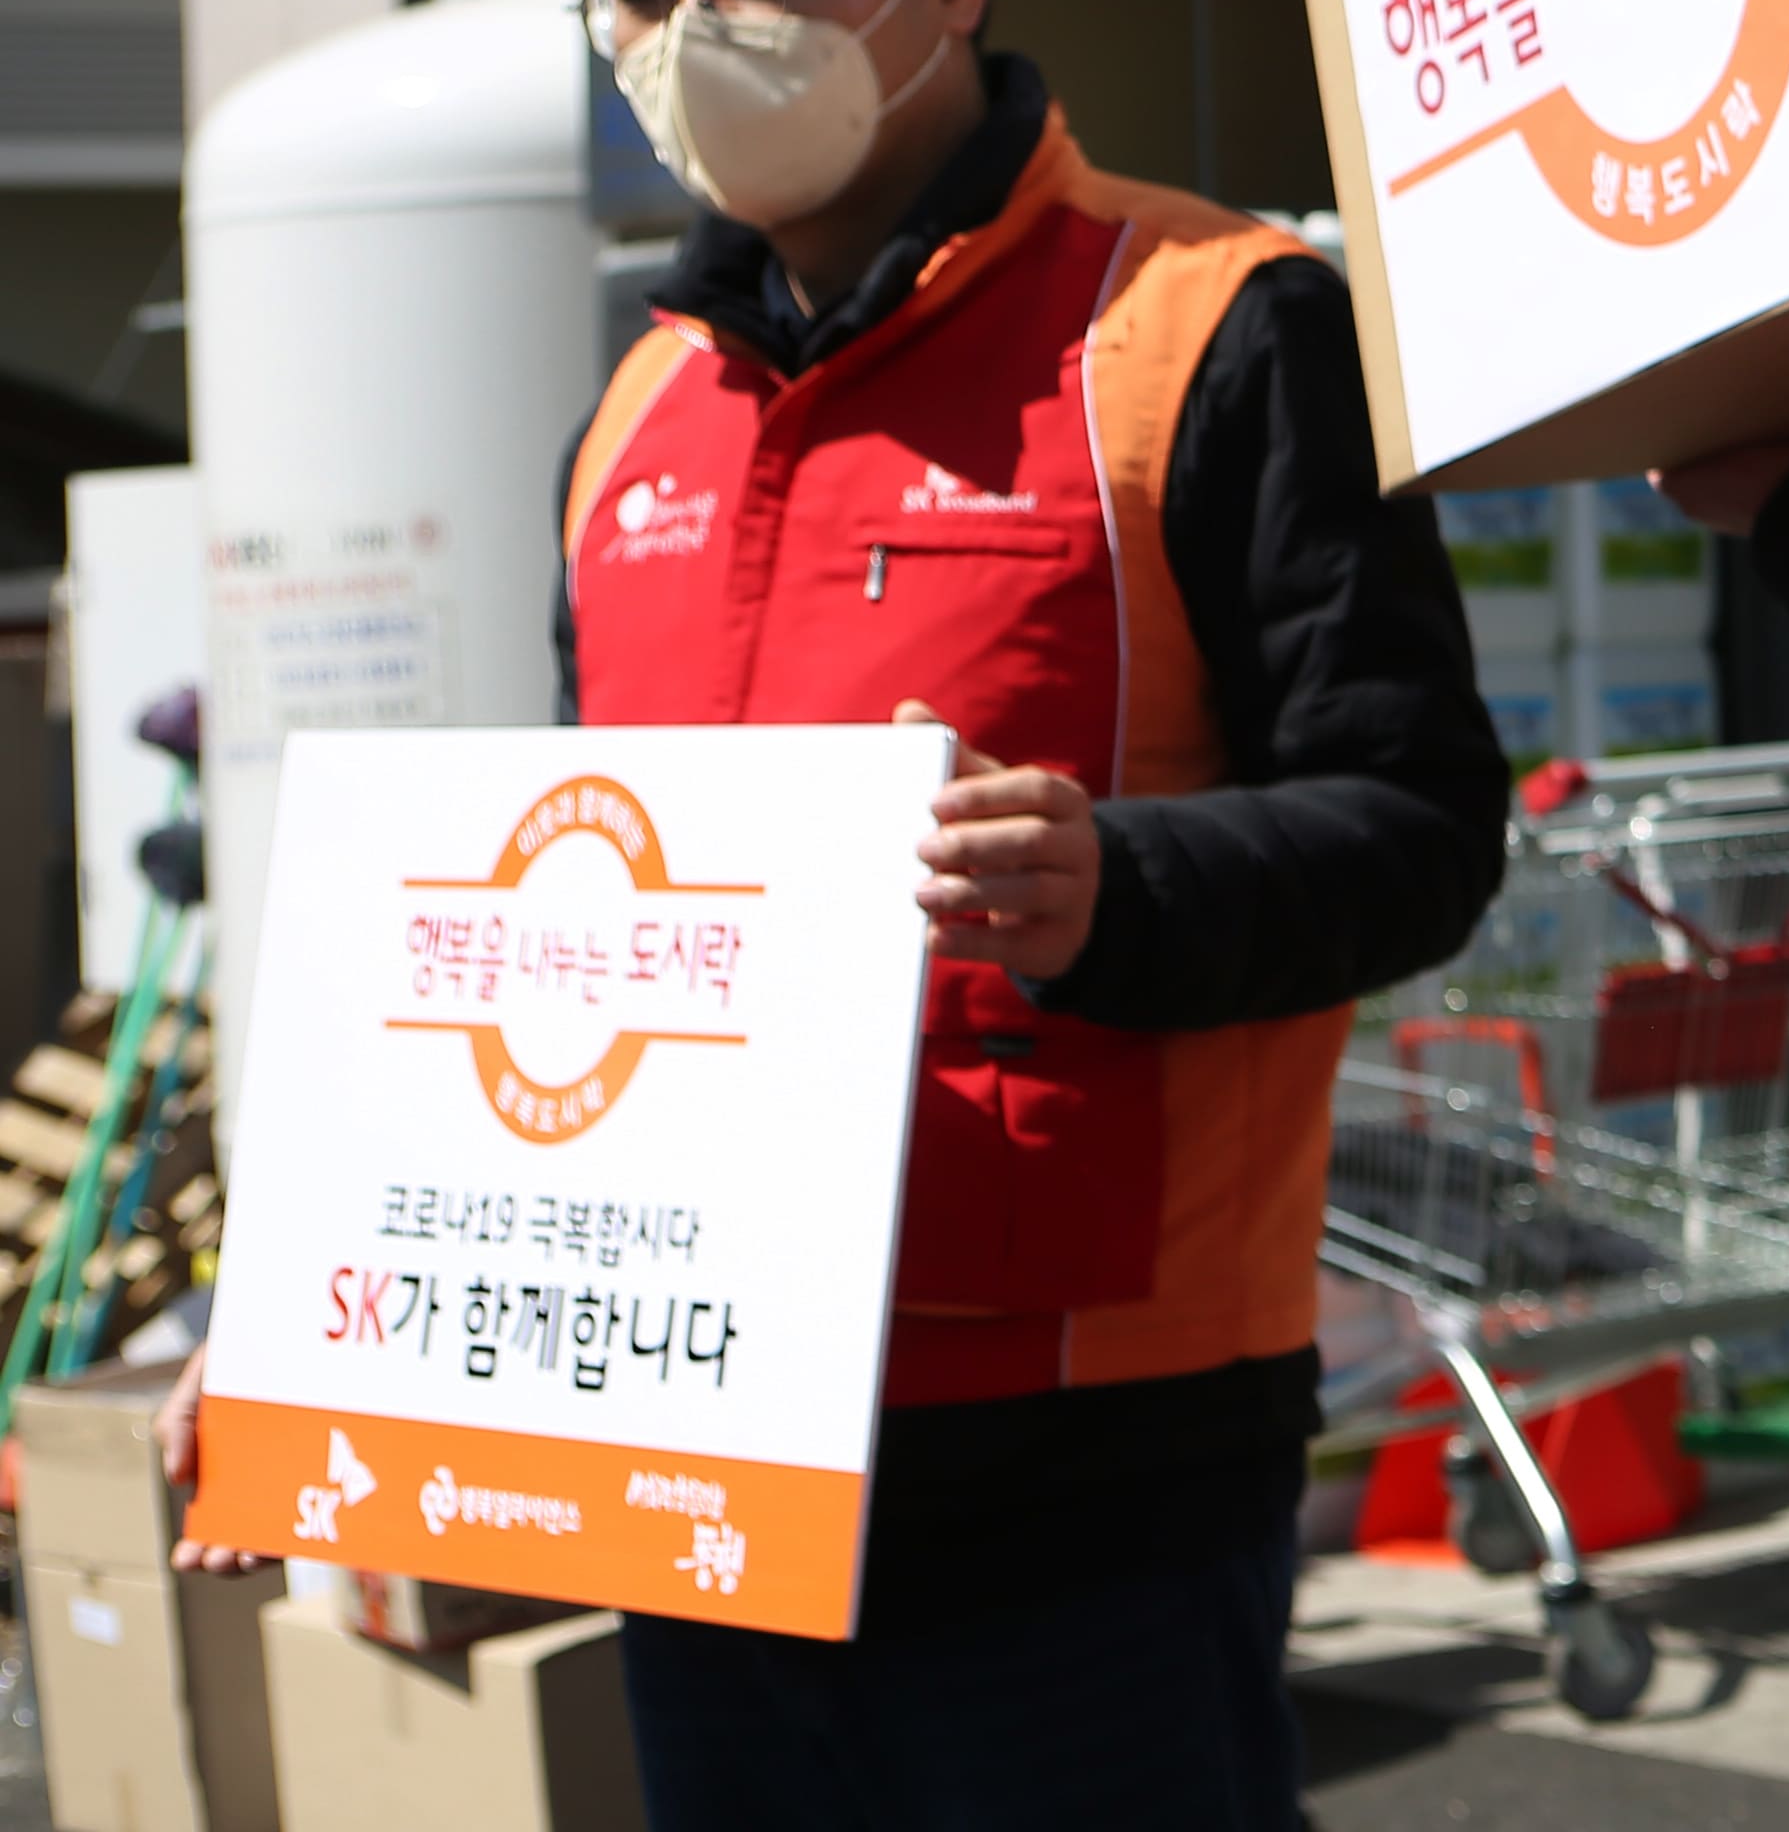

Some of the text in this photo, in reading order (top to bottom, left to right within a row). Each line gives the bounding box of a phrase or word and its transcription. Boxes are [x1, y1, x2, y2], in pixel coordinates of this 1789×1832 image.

[1590, 76, 1763, 227] 행복도시락
[405, 914, 743, 1010] 행복을 나누는 도시락
[375, 1185, 702, 1267] 코로나19 극복합시다
[325, 1265, 739, 1392] SK가 함께합니다
[293, 1484, 342, 1543] SK
